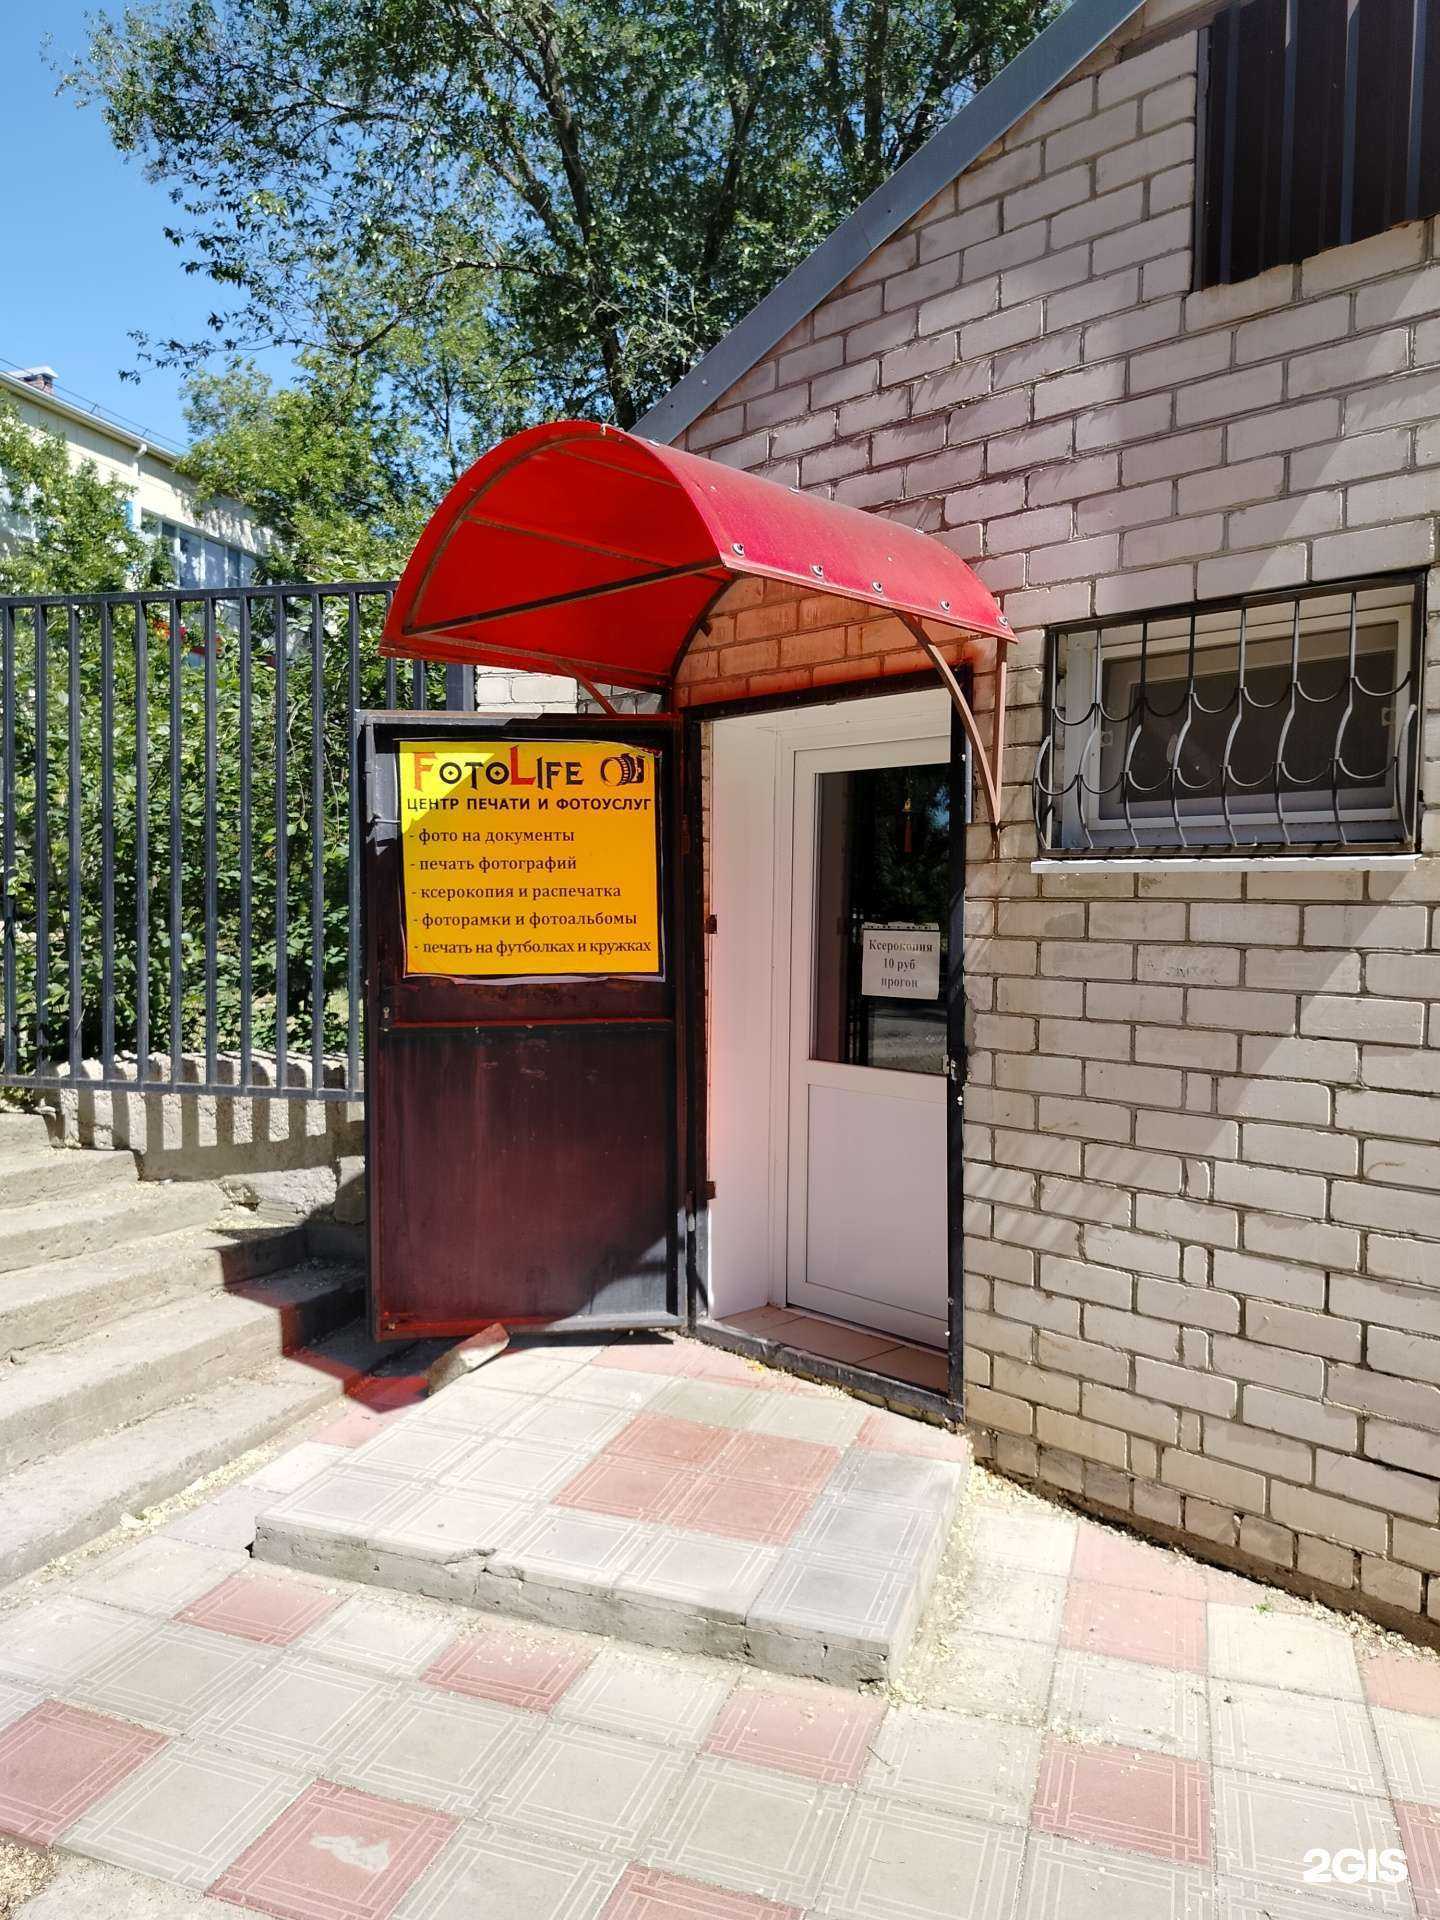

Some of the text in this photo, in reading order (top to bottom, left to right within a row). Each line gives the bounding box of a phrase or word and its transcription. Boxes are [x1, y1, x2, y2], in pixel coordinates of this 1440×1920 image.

[407, 798, 652, 812] ЦЕНТР ПЕЧАТИ И ФОТОУСЛУГ
[419, 828, 458, 845] фото
[462, 831, 480, 842] на
[485, 831, 575, 845] документы
[419, 858, 475, 870] печать
[479, 856, 577, 873] фотографий
[421, 886, 514, 901] ксерокопия
[518, 887, 528, 898] и
[532, 885, 621, 901] распечатка
[422, 913, 511, 929] фоторамки
[515, 914, 525, 925] и
[529, 912, 638, 929] фотоальбомы
[423, 942, 473, 954] печать
[475, 942, 493, 953] на
[496, 940, 574, 957] футболках
[578, 942, 586, 952] и
[590, 941, 652, 955] кружках
[869, 939, 933, 953] Ксерокопия
[883, 958, 916, 972] 10 руб
[881, 977, 918, 989] прогон
